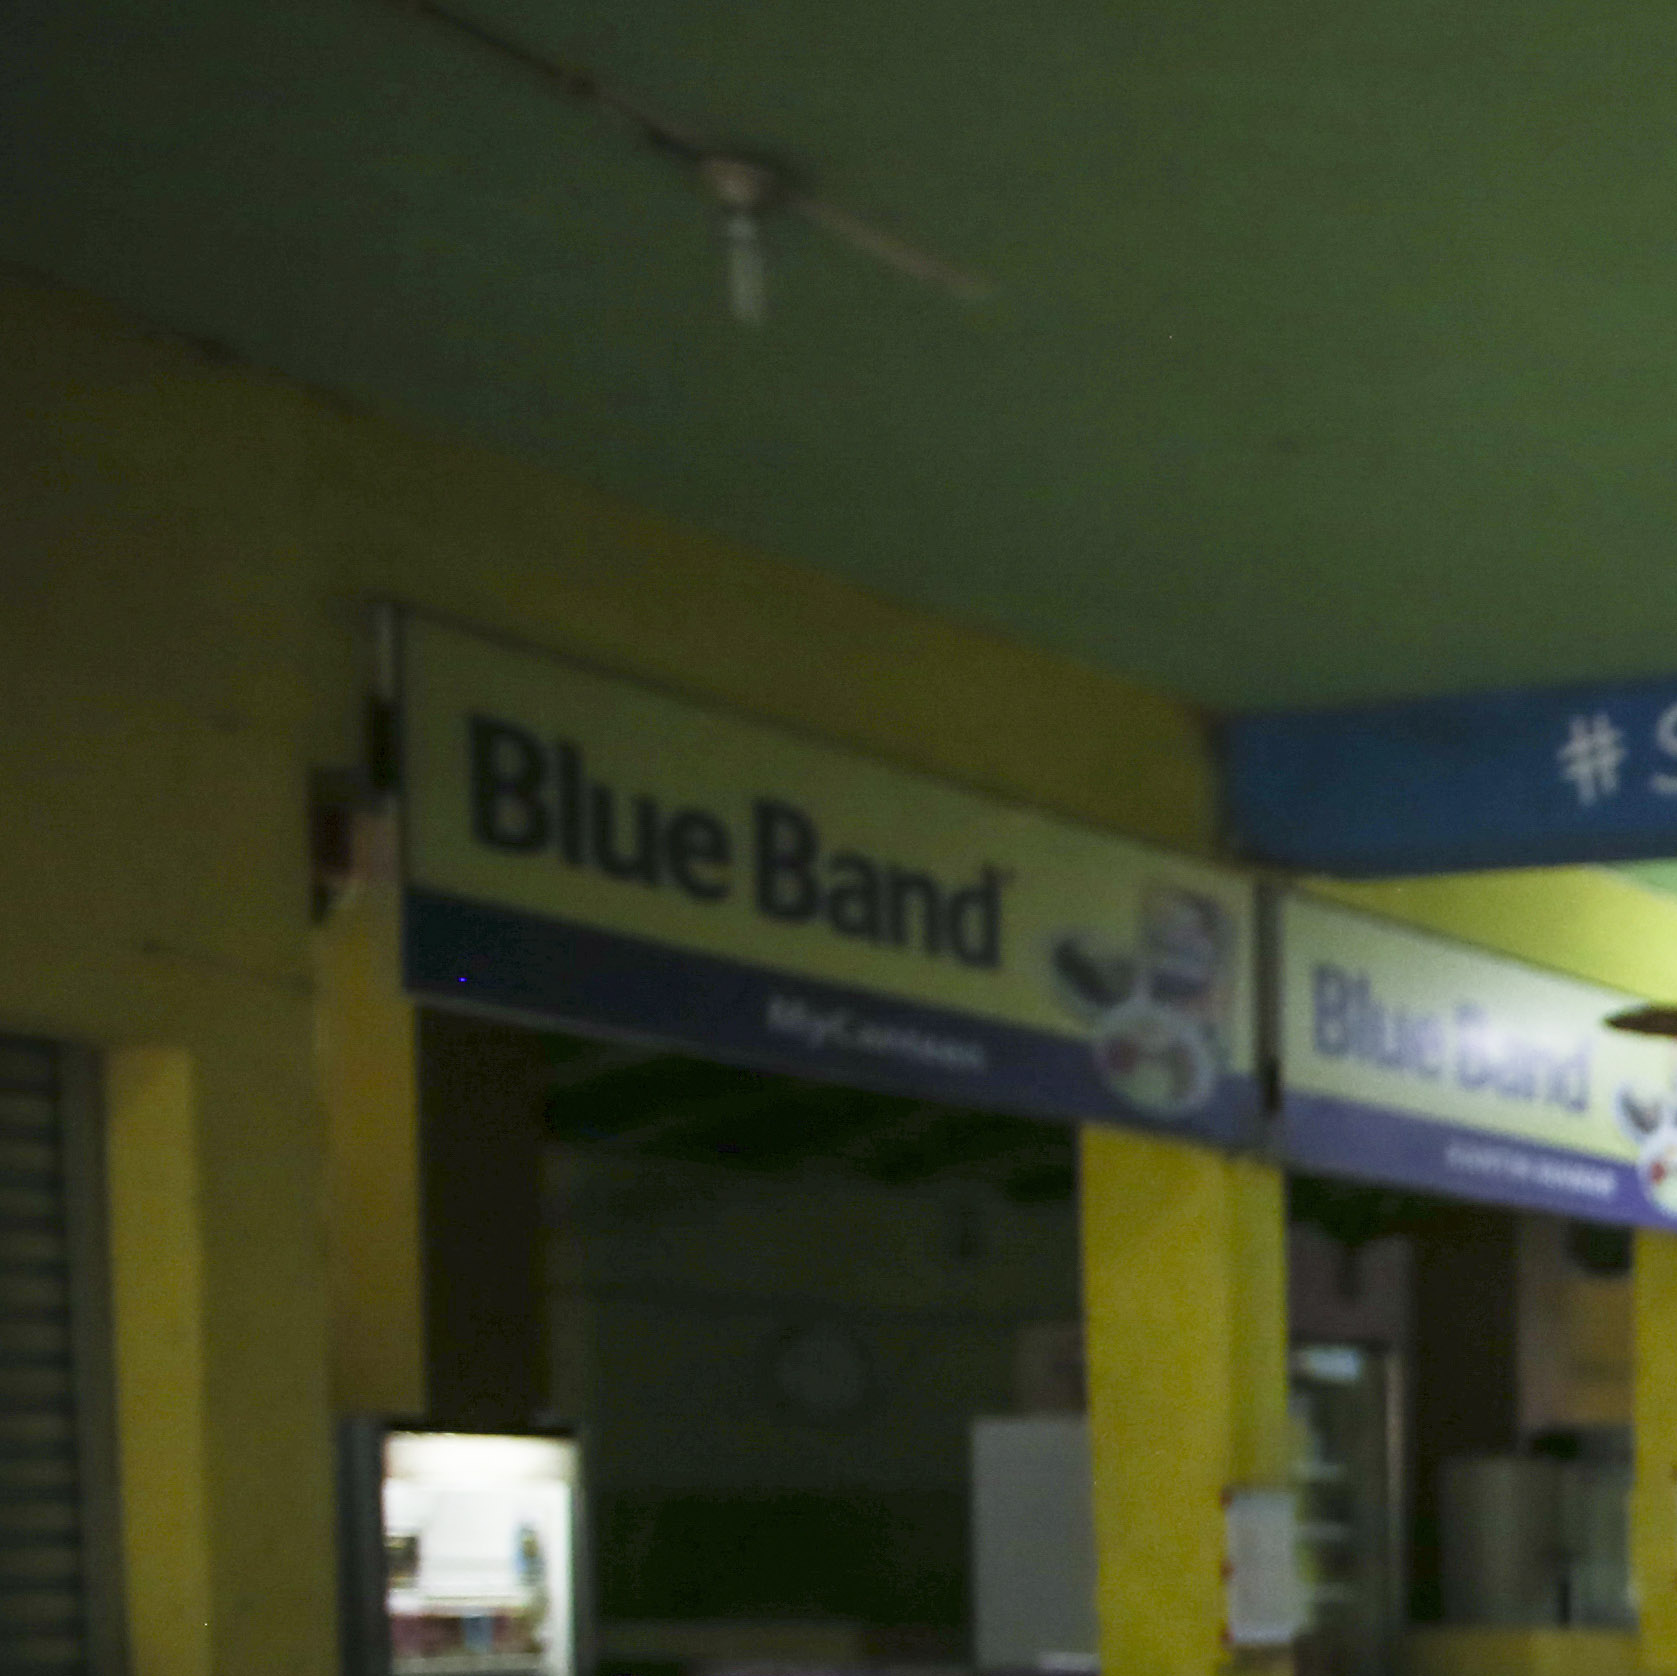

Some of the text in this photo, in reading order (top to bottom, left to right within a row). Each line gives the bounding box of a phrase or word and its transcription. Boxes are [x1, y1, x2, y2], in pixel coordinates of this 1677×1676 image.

[466, 713, 1005, 969] Blue Band
[1312, 960, 1593, 1114] Blue Band
